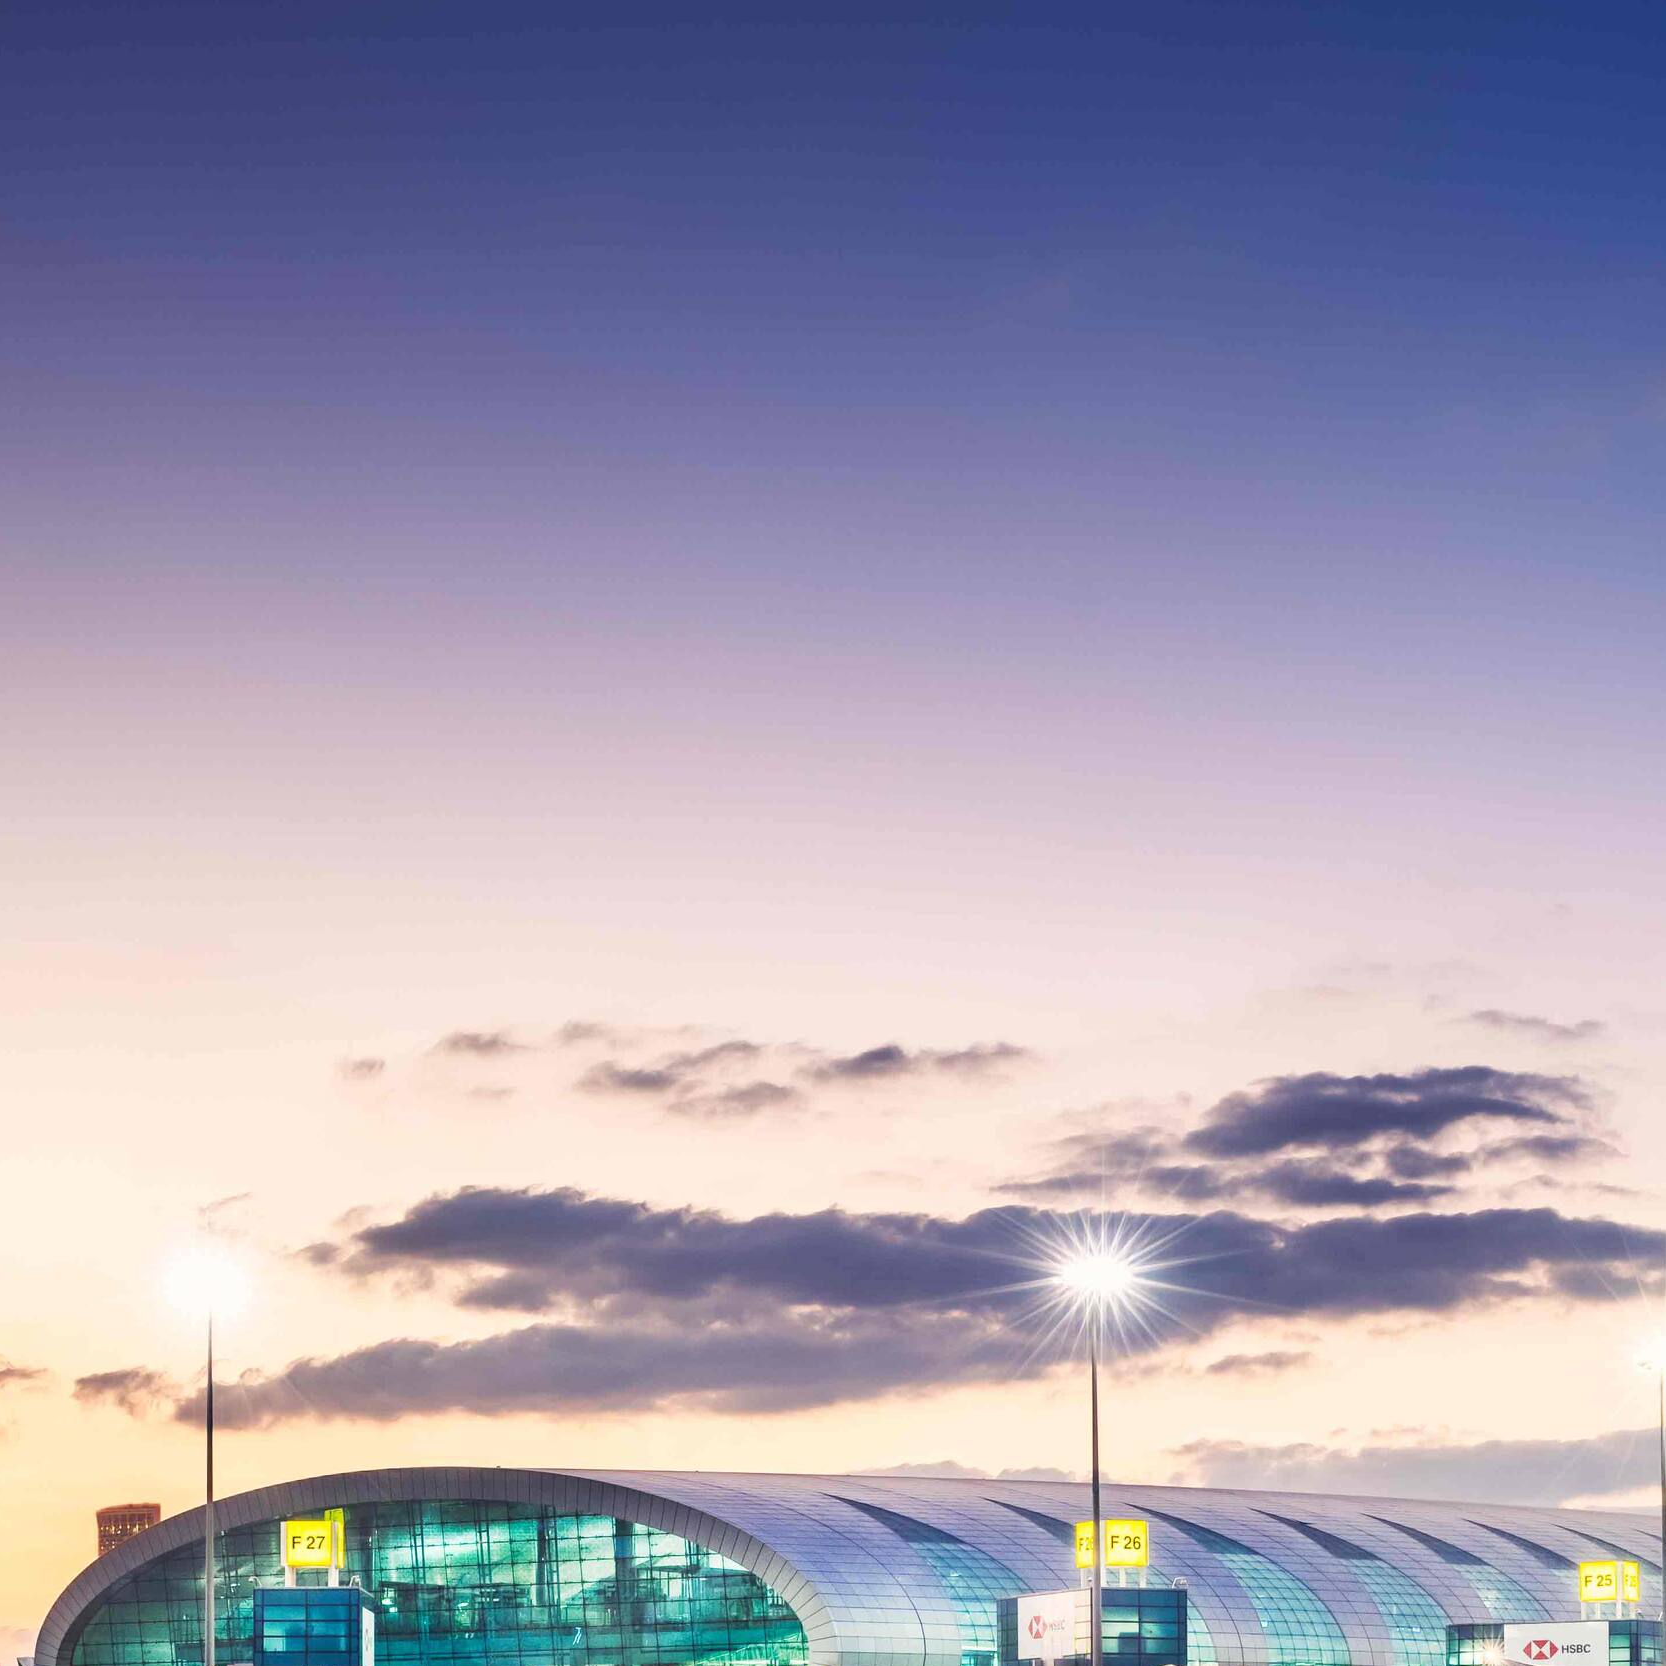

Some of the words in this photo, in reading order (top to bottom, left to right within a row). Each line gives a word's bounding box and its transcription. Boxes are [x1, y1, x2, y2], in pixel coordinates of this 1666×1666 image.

[292, 1535, 302, 1550] F
[306, 1535, 325, 1550] 27
[1111, 1536, 1120, 1549] F
[1124, 1536, 1141, 1549] 26
[1584, 1575, 1593, 1588] F
[1596, 1574, 1612, 1588] 25
[1561, 1644, 1591, 1654] HSBC
